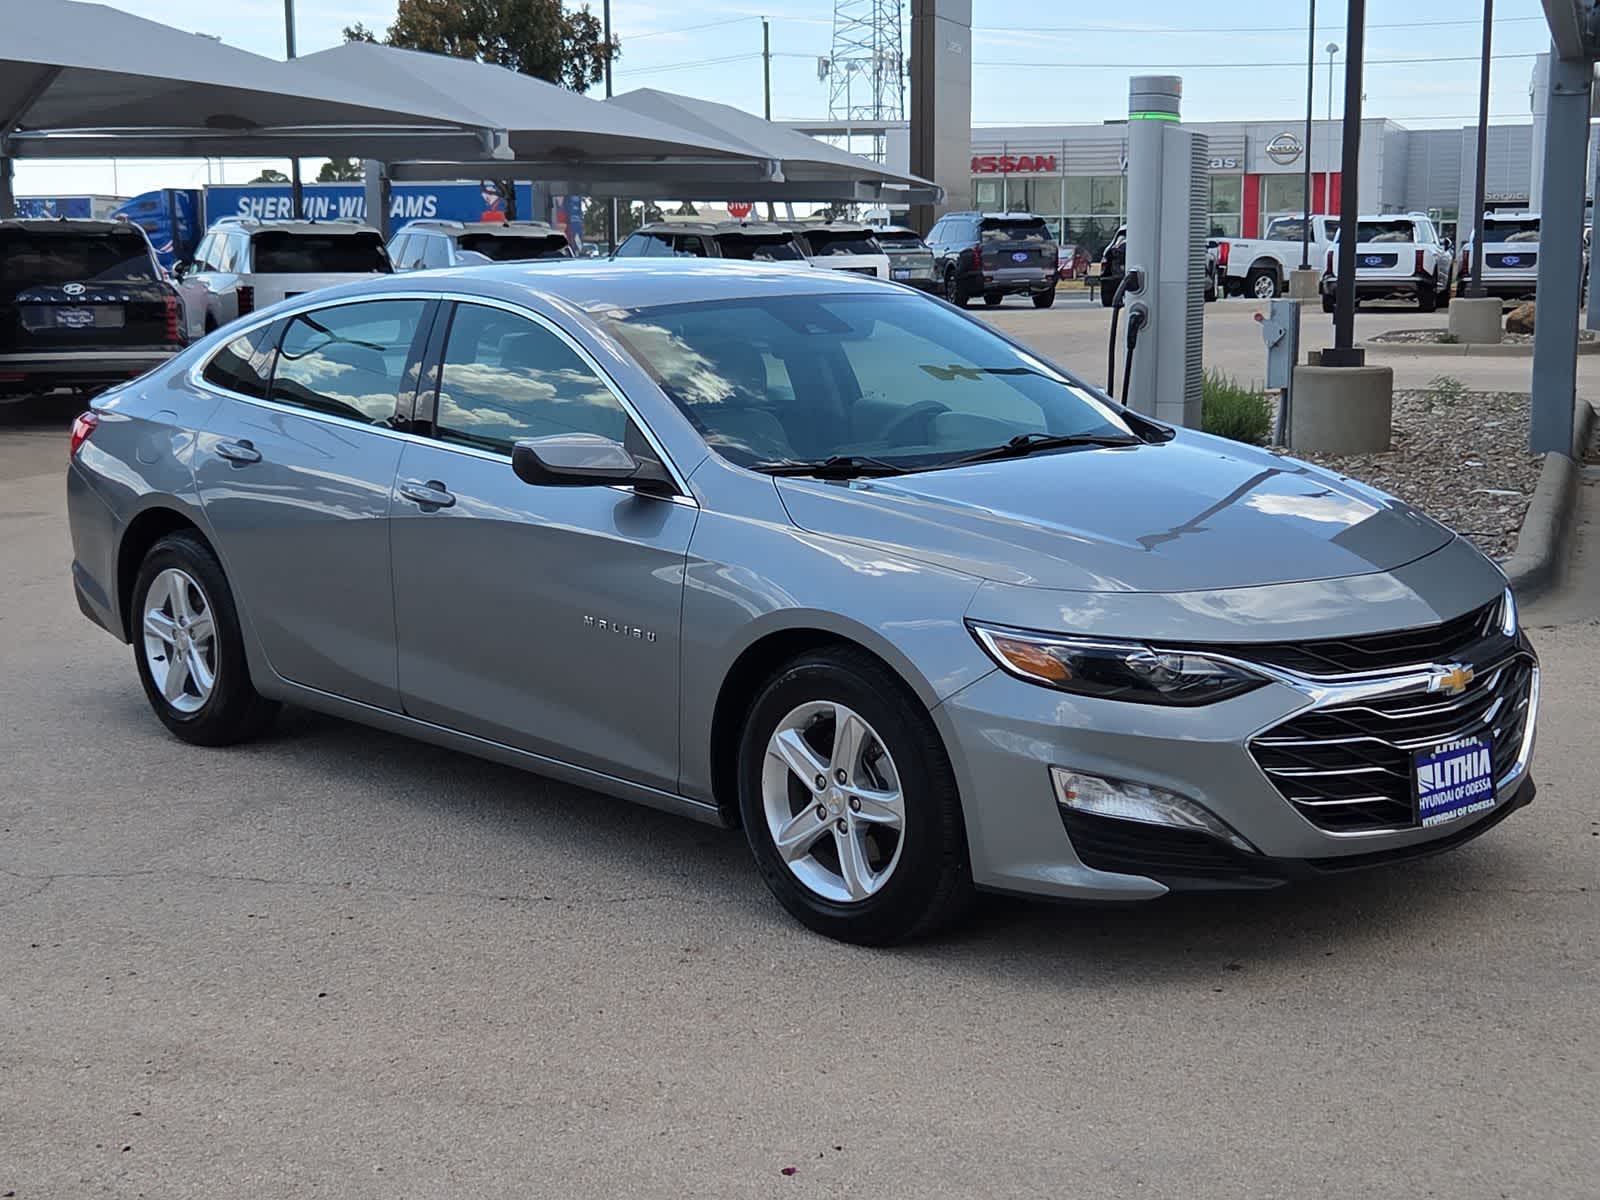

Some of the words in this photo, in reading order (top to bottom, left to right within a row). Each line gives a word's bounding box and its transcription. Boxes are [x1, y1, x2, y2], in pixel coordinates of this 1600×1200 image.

[971, 155, 1055, 173] ISSAN
[18, 294, 130, 302] PALISADE
[583, 615, 656, 642] MALIBU
[1435, 736, 1478, 754] LITHIA
[1434, 748, 1491, 790] LITHIA
[1419, 789, 1455, 810] HYUNDAI
[1455, 785, 1465, 800] OF
[1465, 777, 1492, 797] ODESSA
